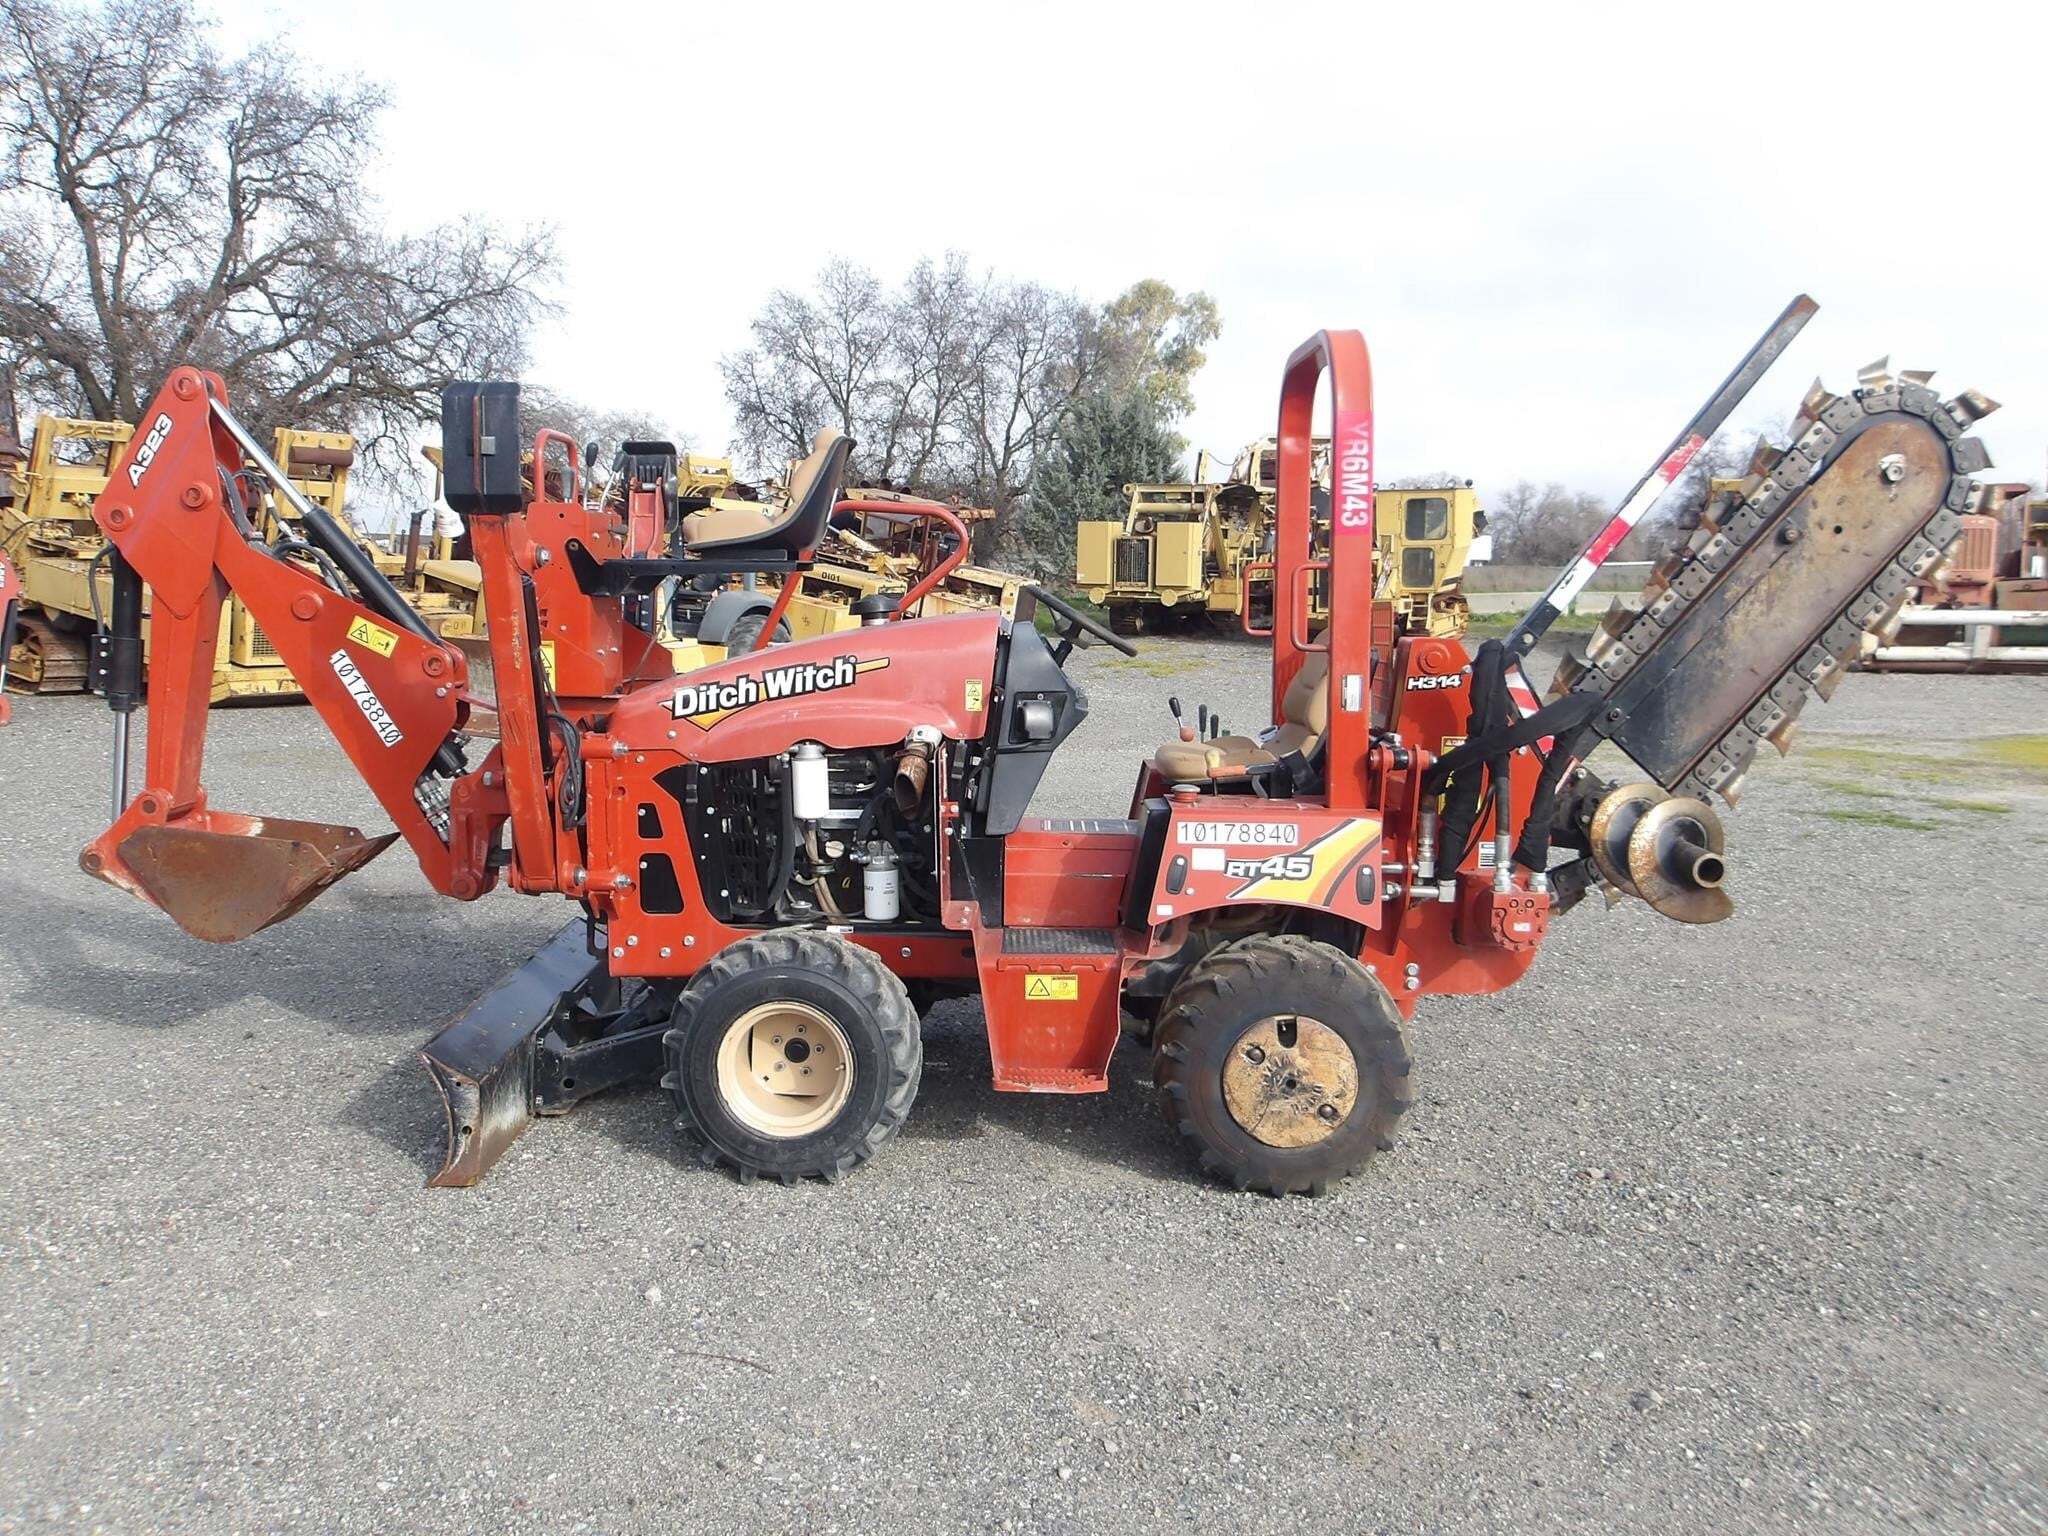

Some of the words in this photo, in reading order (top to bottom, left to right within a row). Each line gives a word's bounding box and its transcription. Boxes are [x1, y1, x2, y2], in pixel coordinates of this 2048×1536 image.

[128, 413, 173, 488] A323
[1341, 421, 1369, 527] YR6M43
[332, 652, 401, 744] 10178840
[673, 674, 760, 719] Ditch
[763, 656, 855, 700] Witch
[1406, 674, 1462, 691] H314
[1180, 822, 1297, 844] 10178840
[1226, 855, 1313, 879] RT45
